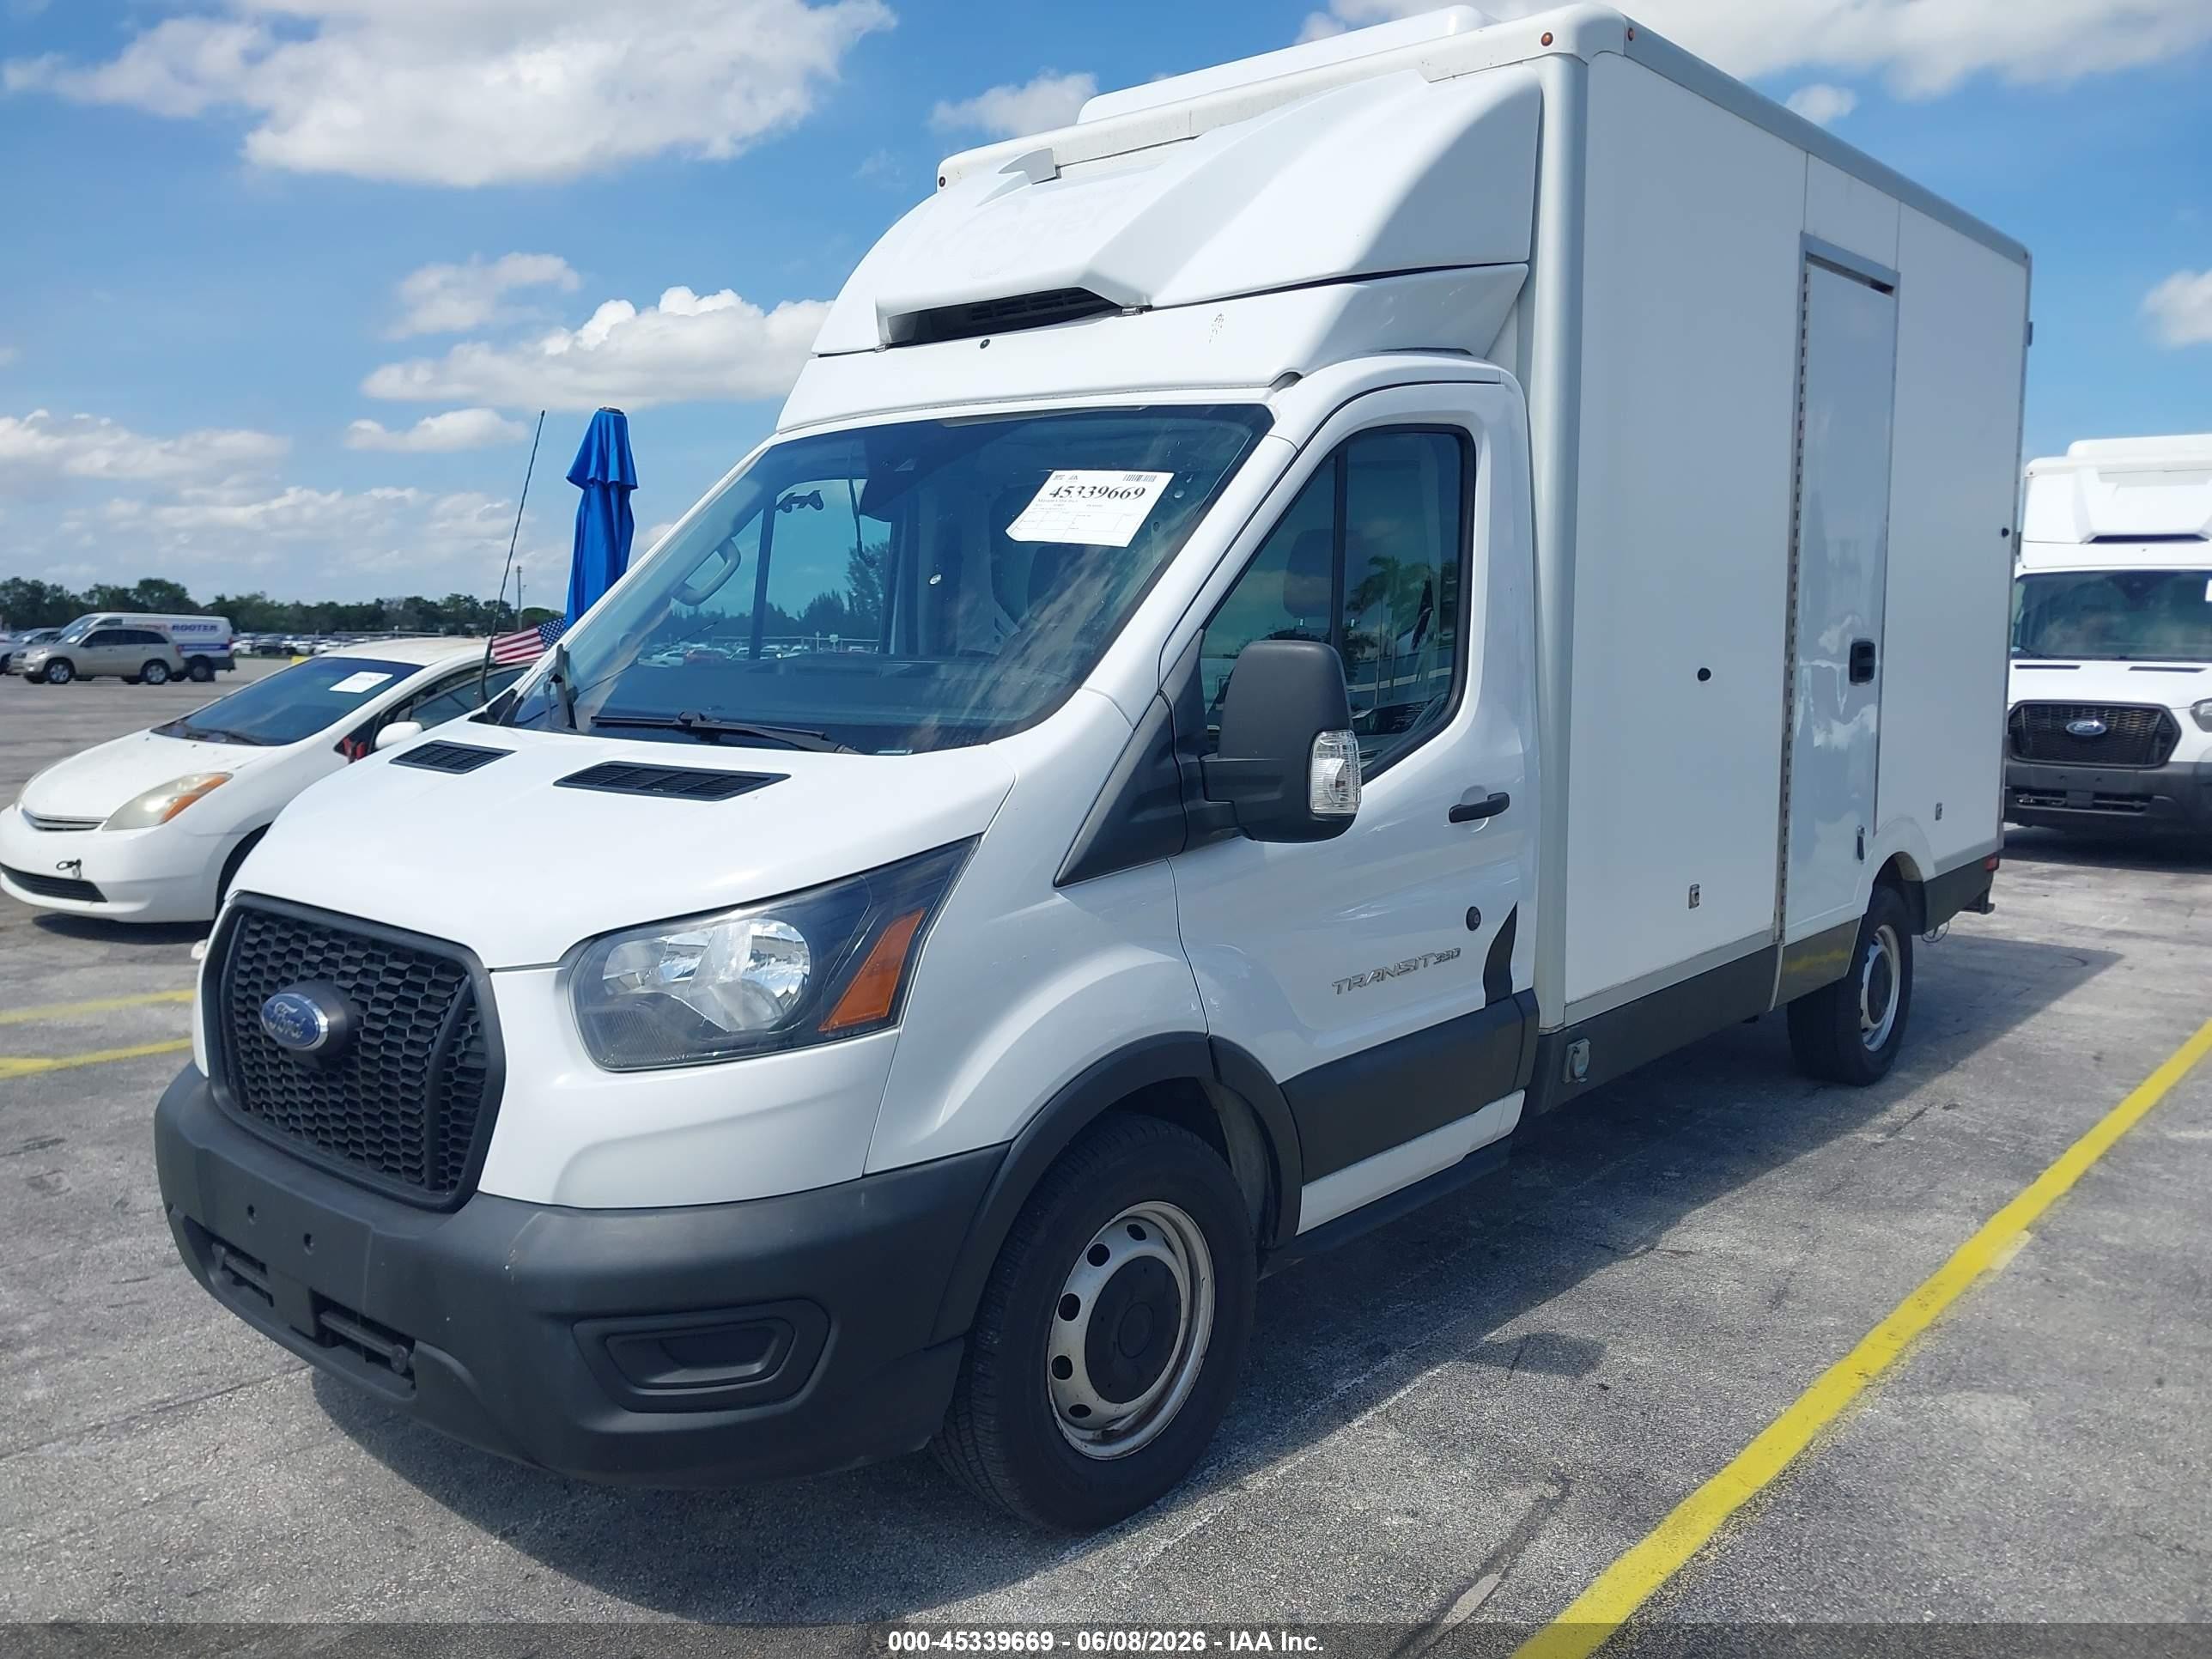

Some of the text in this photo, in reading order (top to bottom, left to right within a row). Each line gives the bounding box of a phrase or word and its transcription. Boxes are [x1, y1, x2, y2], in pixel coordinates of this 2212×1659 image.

[1048, 485, 1146, 500] 45339669
[171, 623, 218, 632] ROOTER
[1332, 952, 1436, 994] TRANSIT
